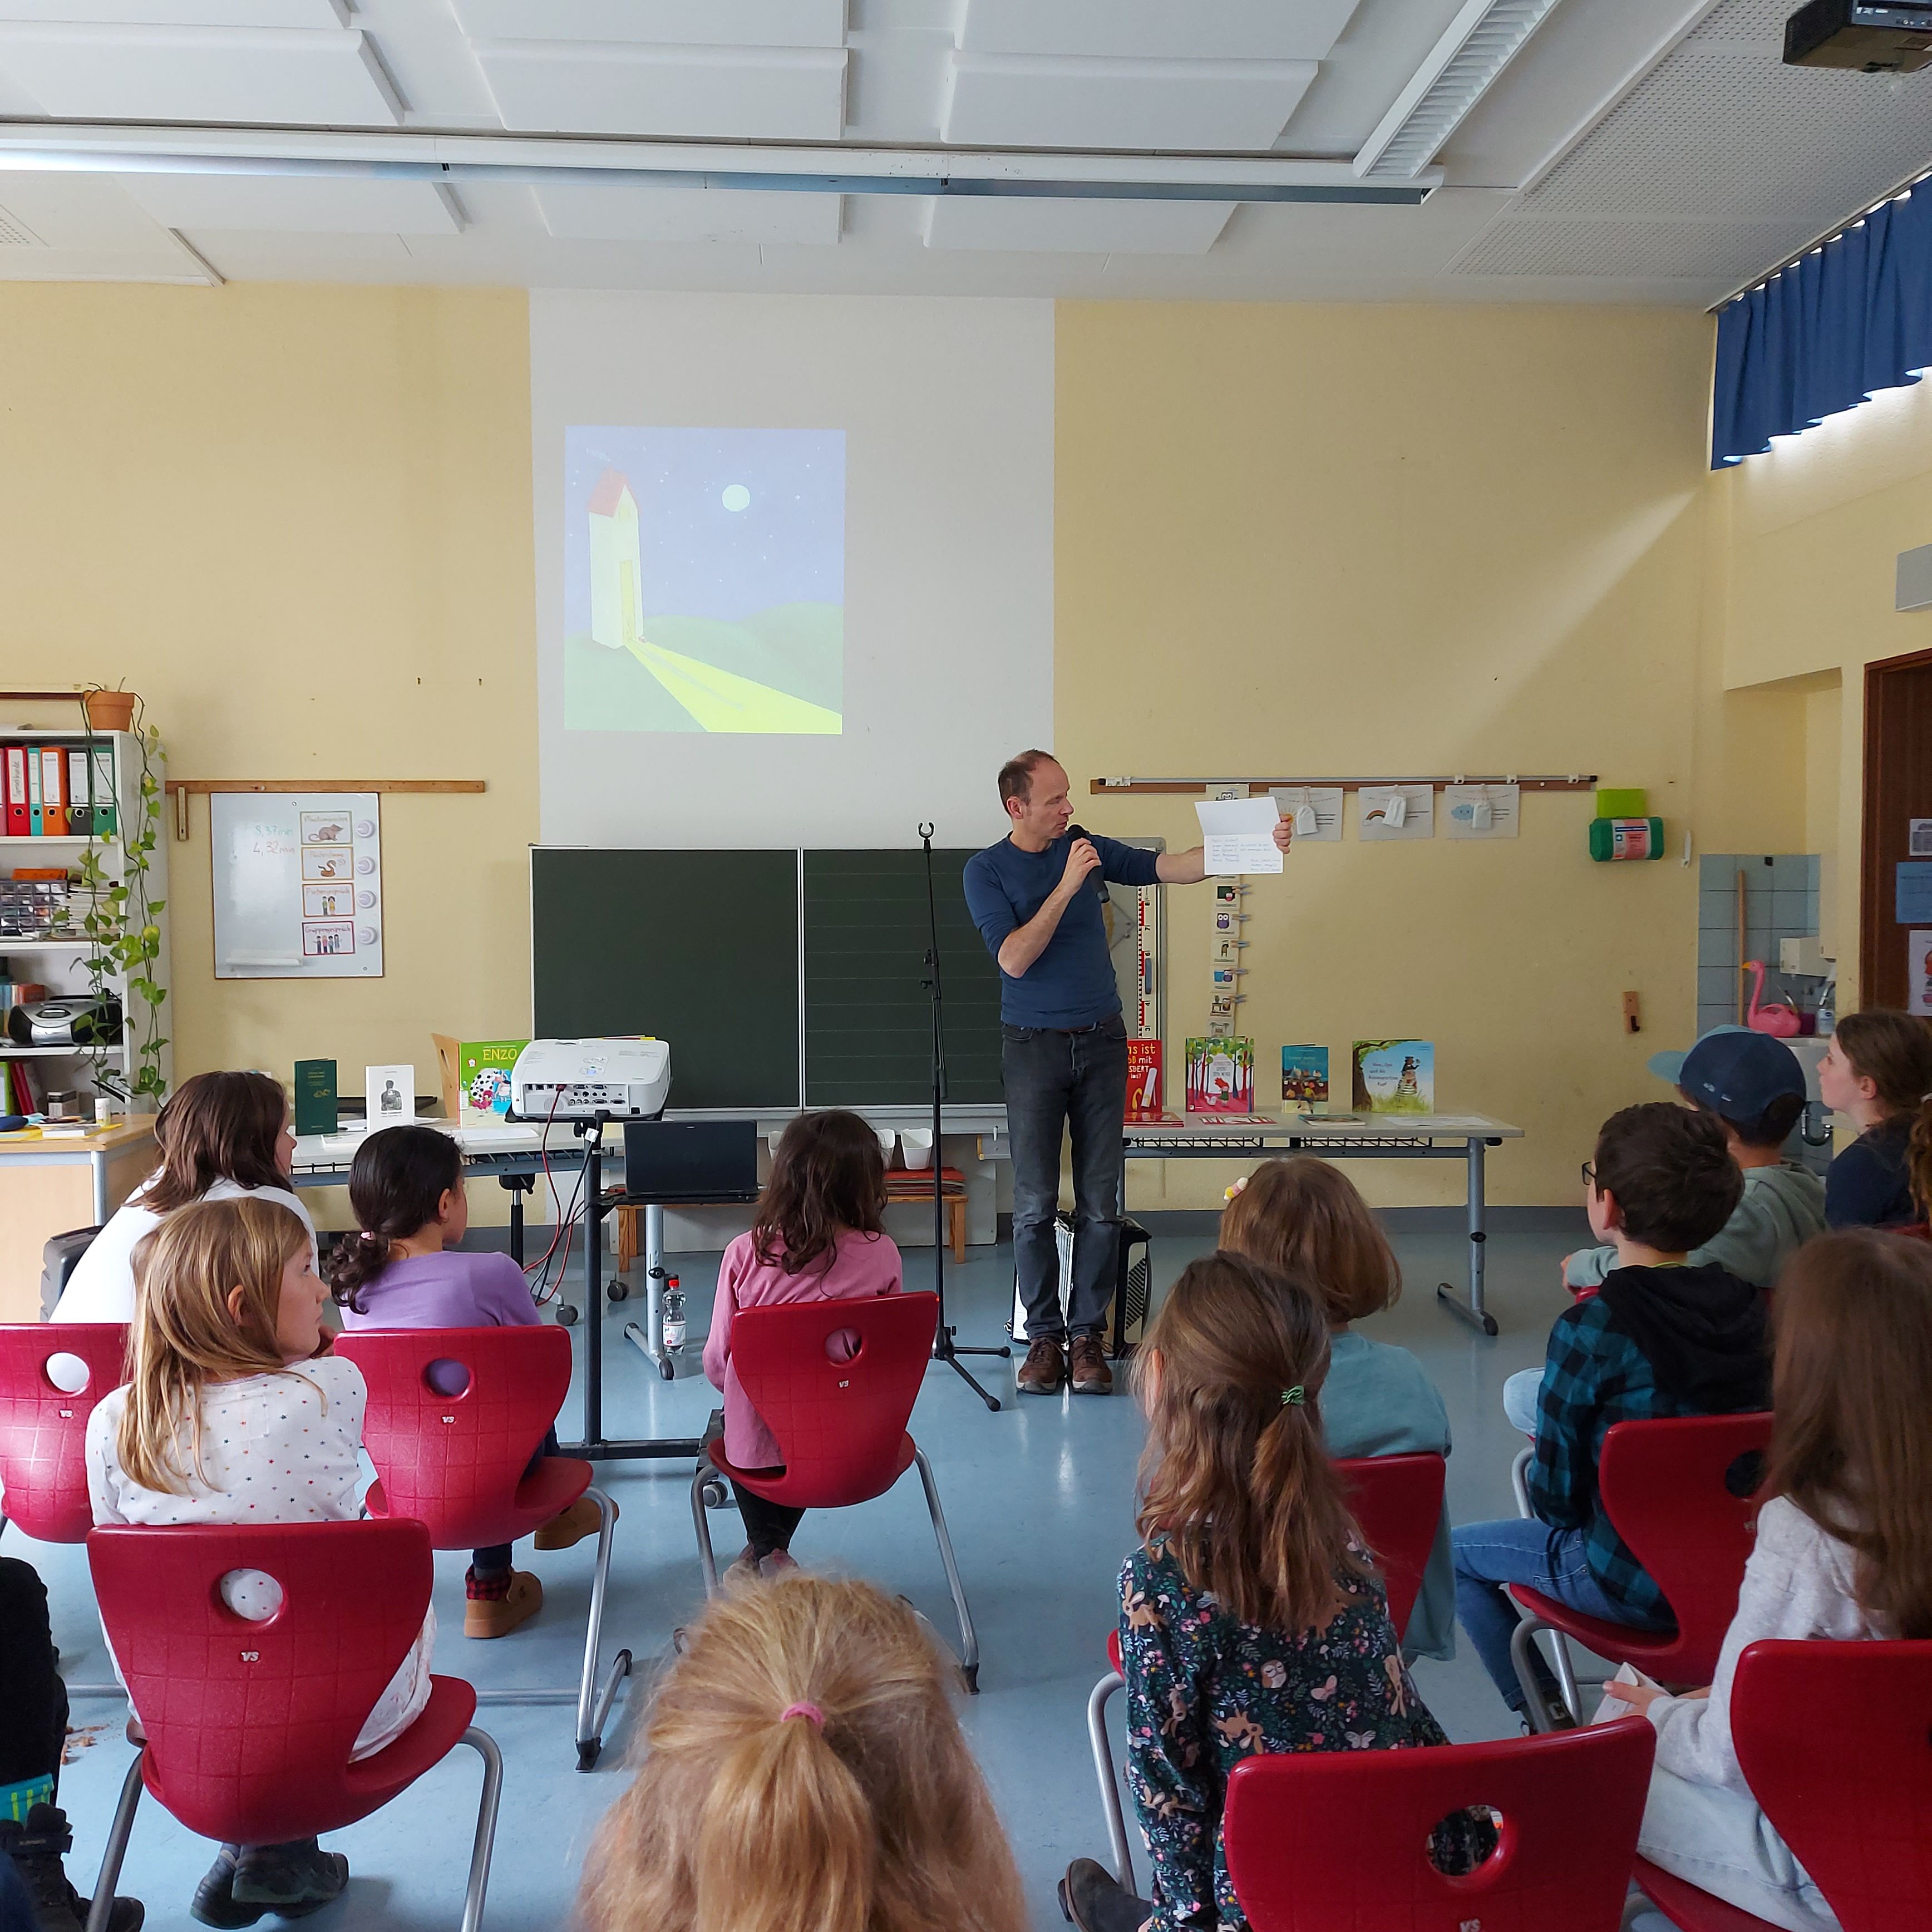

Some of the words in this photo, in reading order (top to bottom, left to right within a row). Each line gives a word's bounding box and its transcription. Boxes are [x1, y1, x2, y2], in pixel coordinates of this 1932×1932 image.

[1141, 1042, 1156, 1054] ist
[482, 1048, 517, 1060] ENZO
[1138, 1056, 1152, 1064] mit
[241, 1651, 259, 1662] VS
